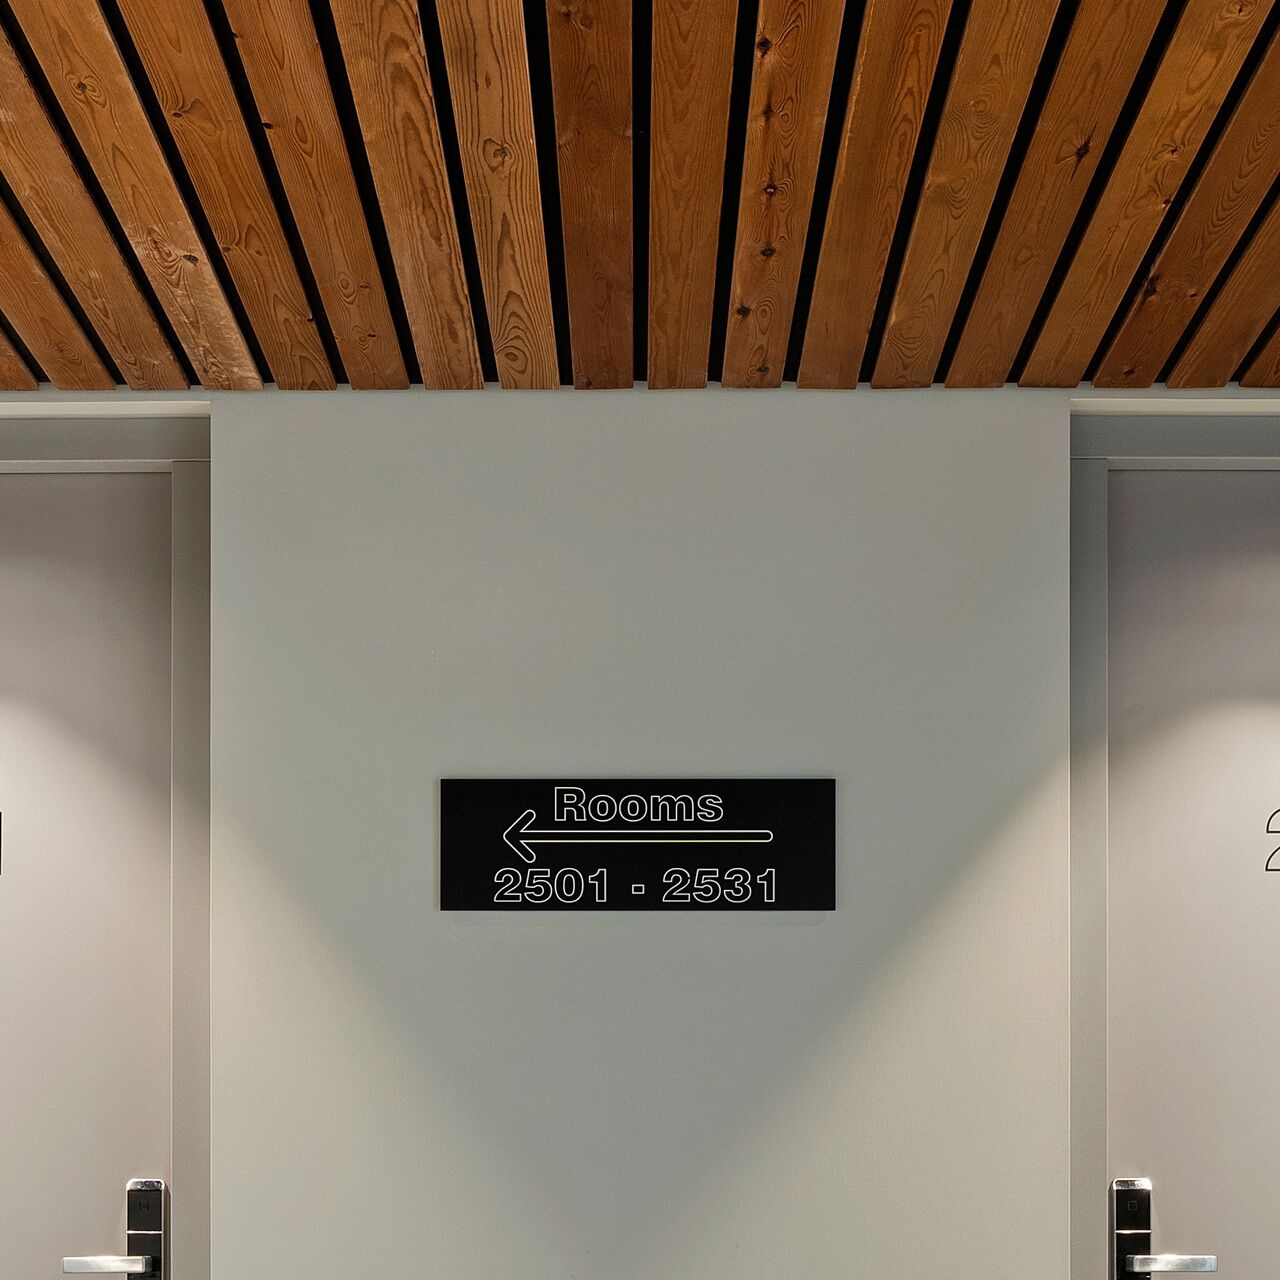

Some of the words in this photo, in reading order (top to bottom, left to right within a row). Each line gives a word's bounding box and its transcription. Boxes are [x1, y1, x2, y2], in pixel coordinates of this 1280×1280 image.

[554, 786, 723, 822] Rooms
[493, 868, 608, 903] 2501
[632, 884, 645, 895] -
[662, 868, 776, 903] 2531
